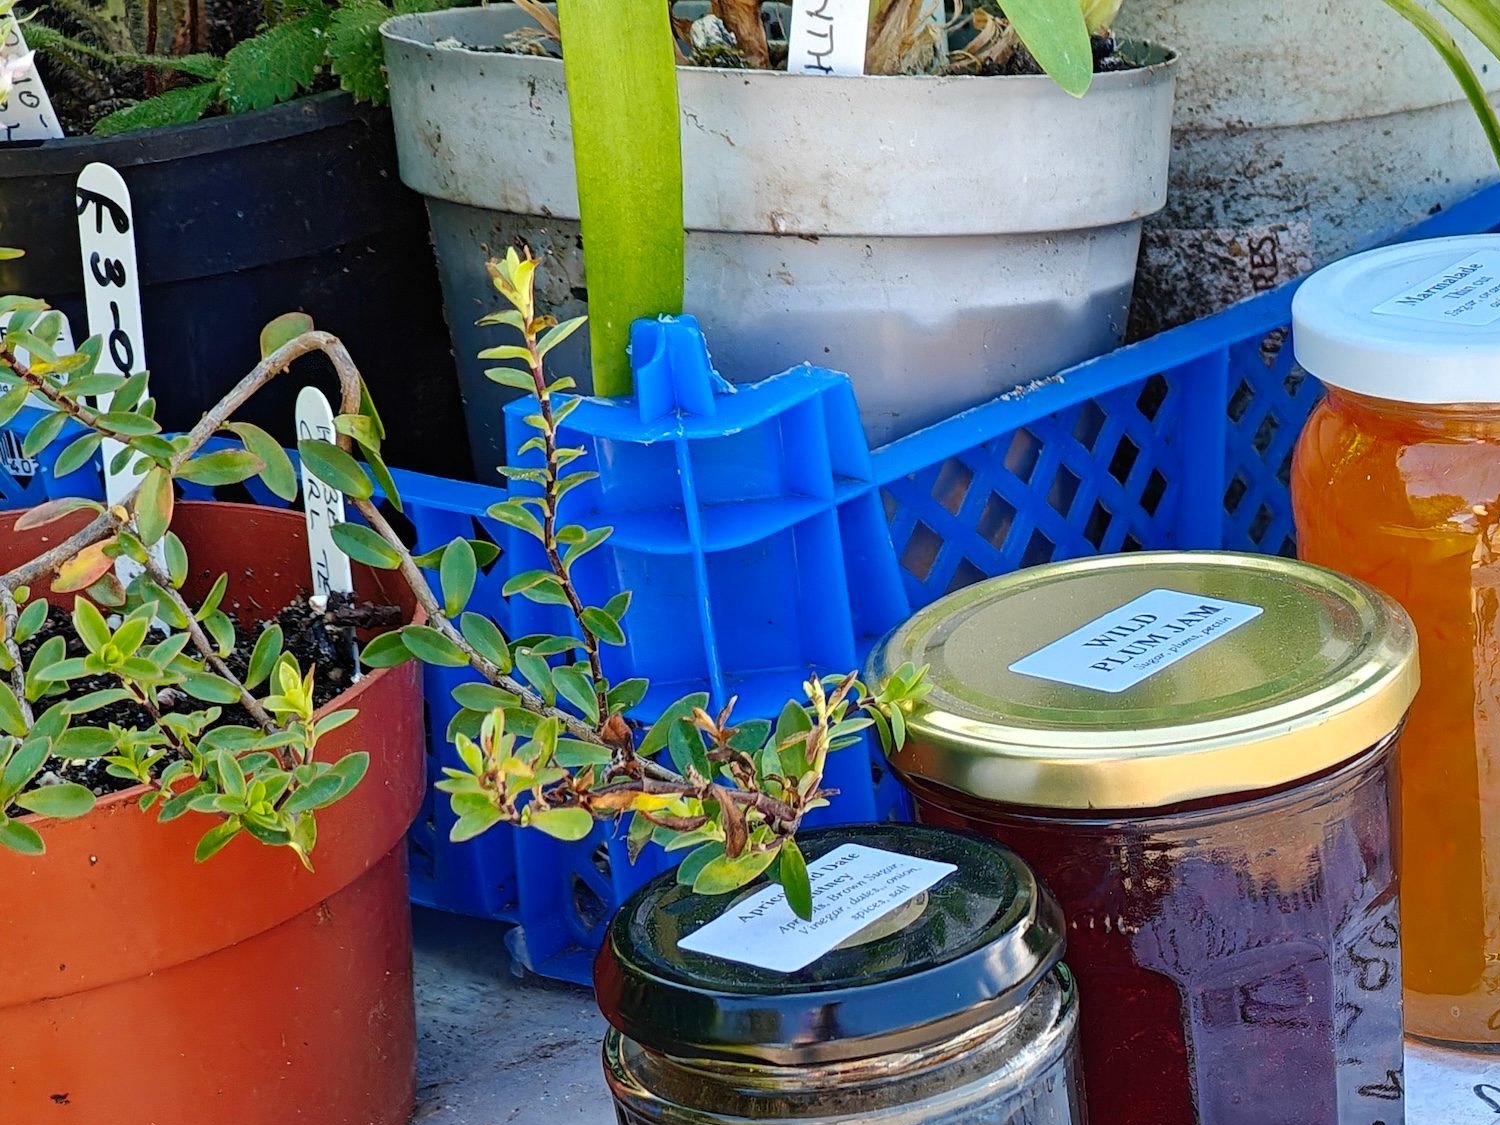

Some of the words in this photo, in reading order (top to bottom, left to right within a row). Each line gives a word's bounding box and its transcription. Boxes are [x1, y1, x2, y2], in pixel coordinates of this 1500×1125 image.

[1395, 262, 1484, 307] Marmalade
[1082, 612, 1158, 649] WILD
[1201, 616, 1233, 637] pectin
[1089, 633, 1171, 673] PLUM
[1163, 604, 1225, 634] JAM
[820, 852, 860, 872] Date
[826, 879, 867, 901] Brown
[890, 885, 911, 898] salt
